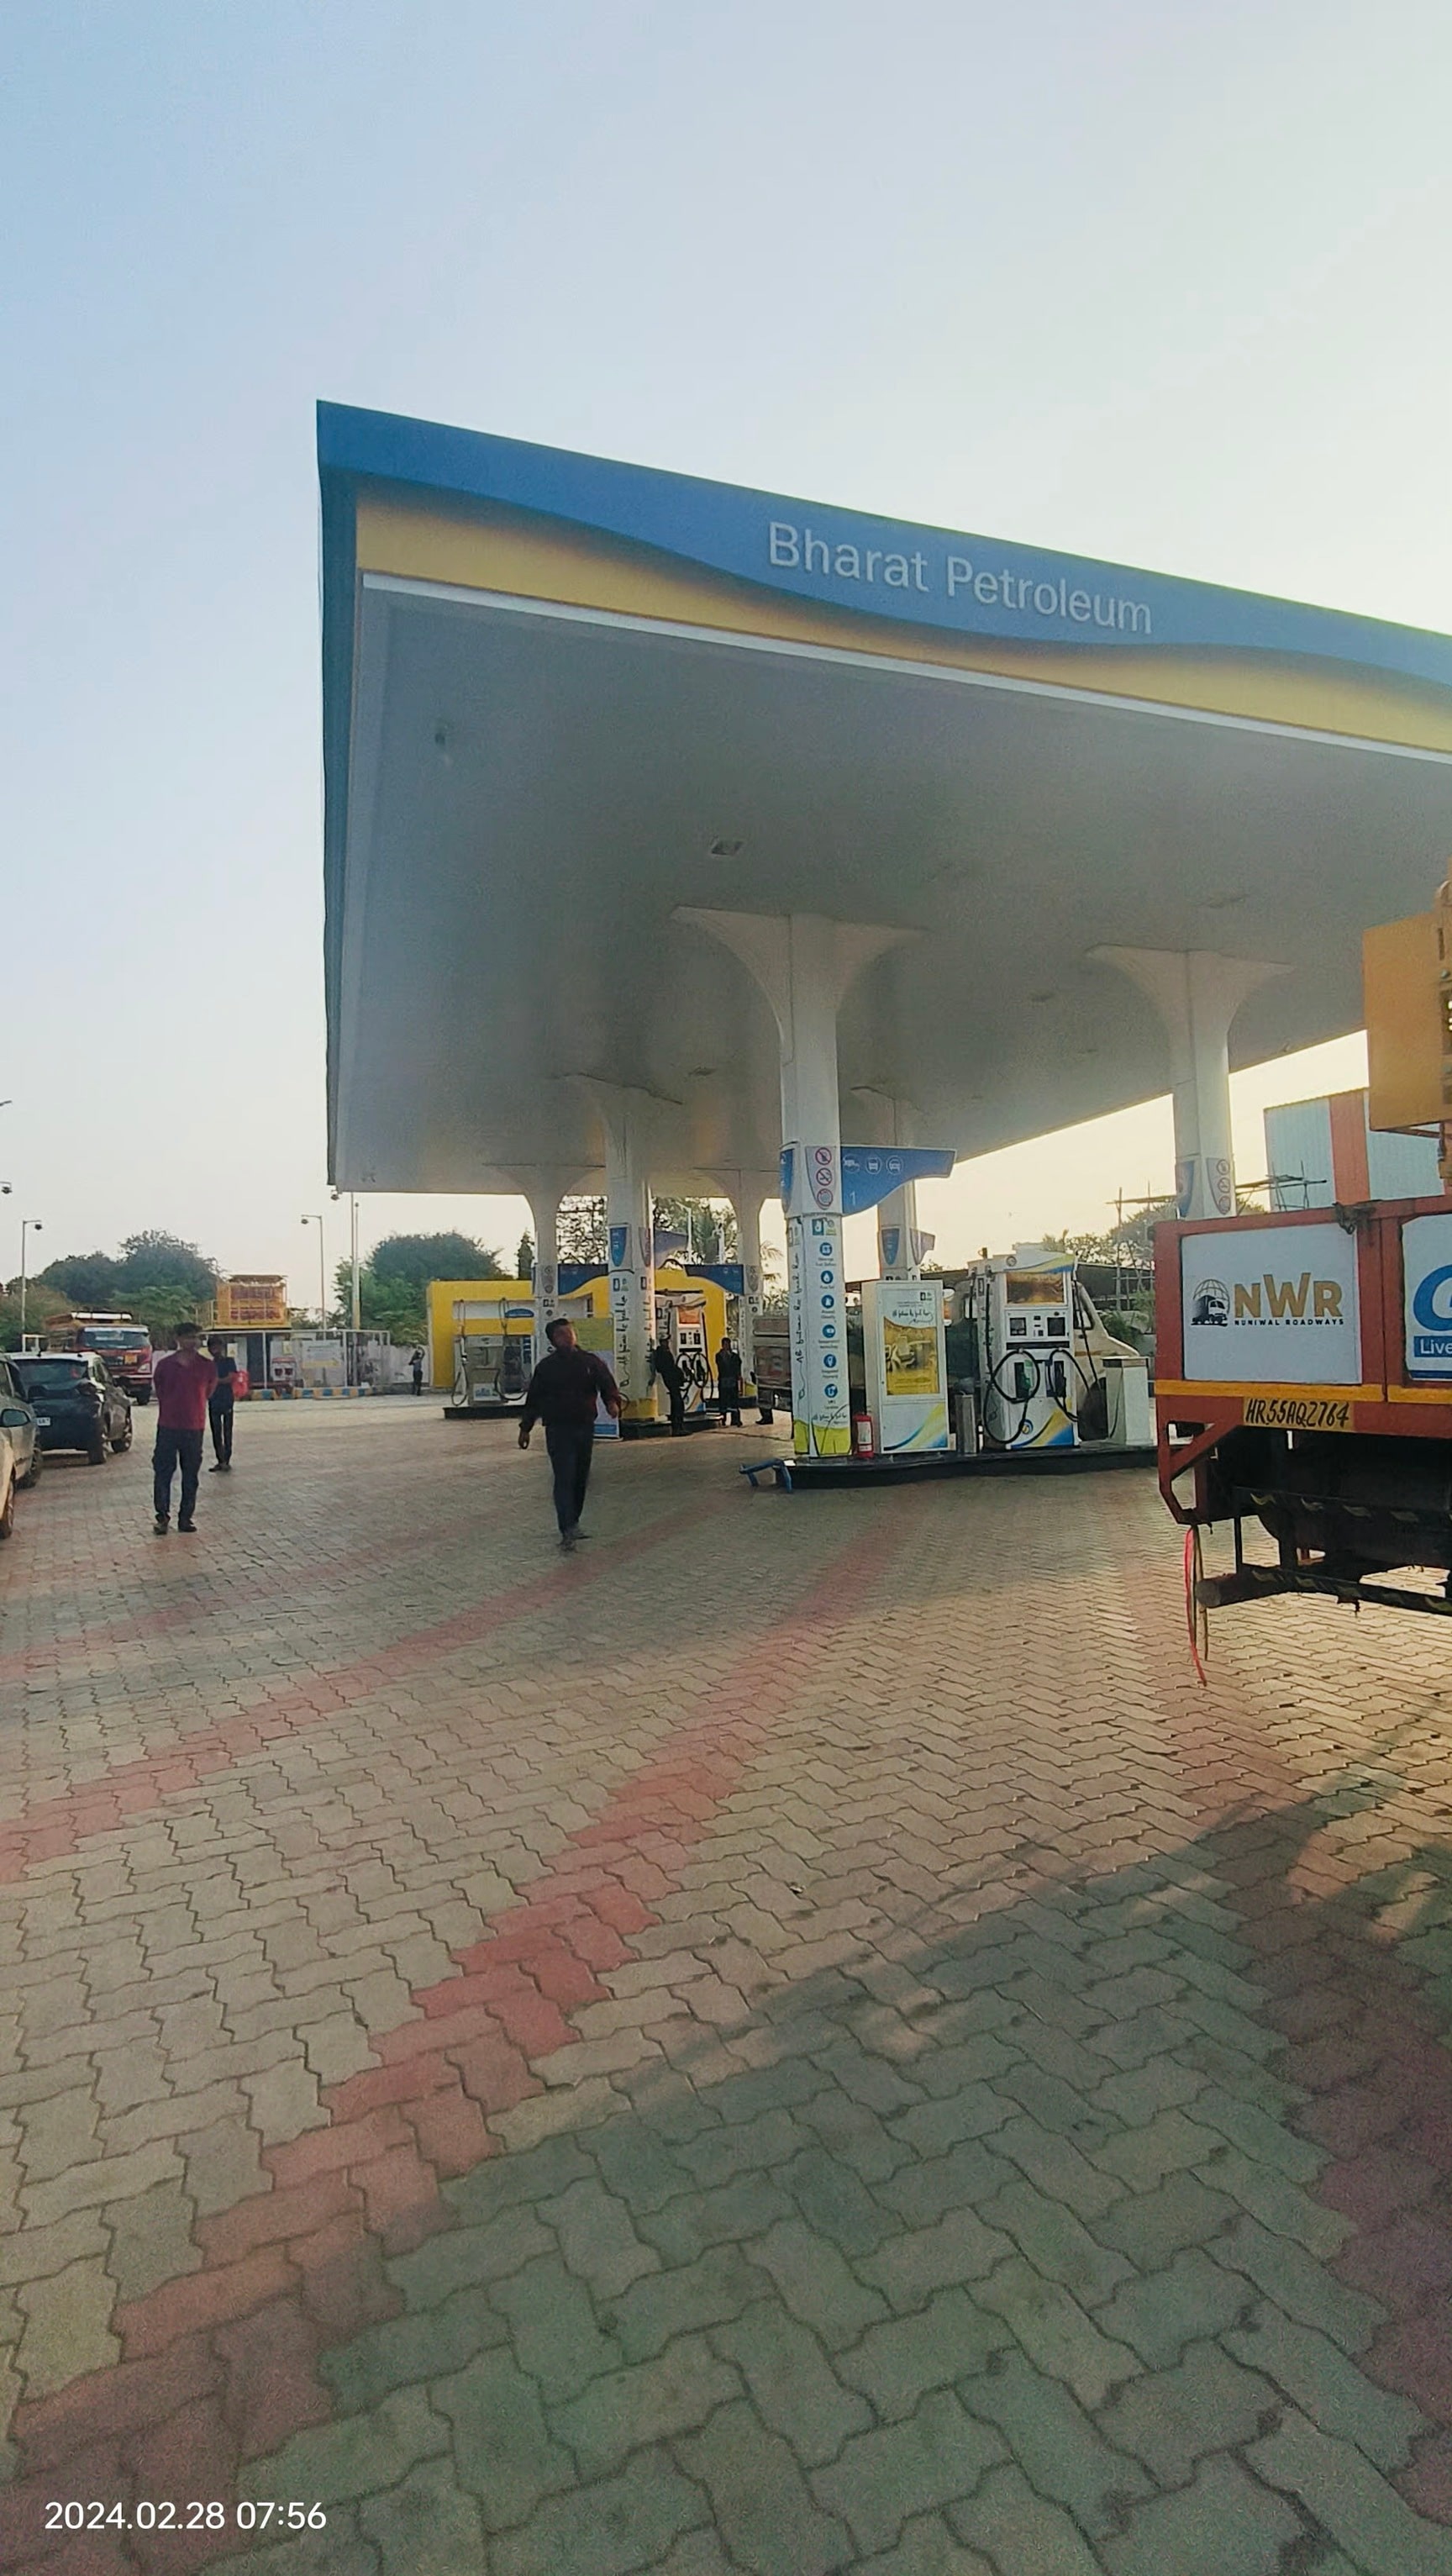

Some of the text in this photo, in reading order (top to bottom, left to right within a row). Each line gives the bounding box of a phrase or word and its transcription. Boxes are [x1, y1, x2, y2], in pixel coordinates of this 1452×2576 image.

[769, 521, 1152, 634] Bharat Petroleum
[1234, 1272, 1343, 1318] NWR
